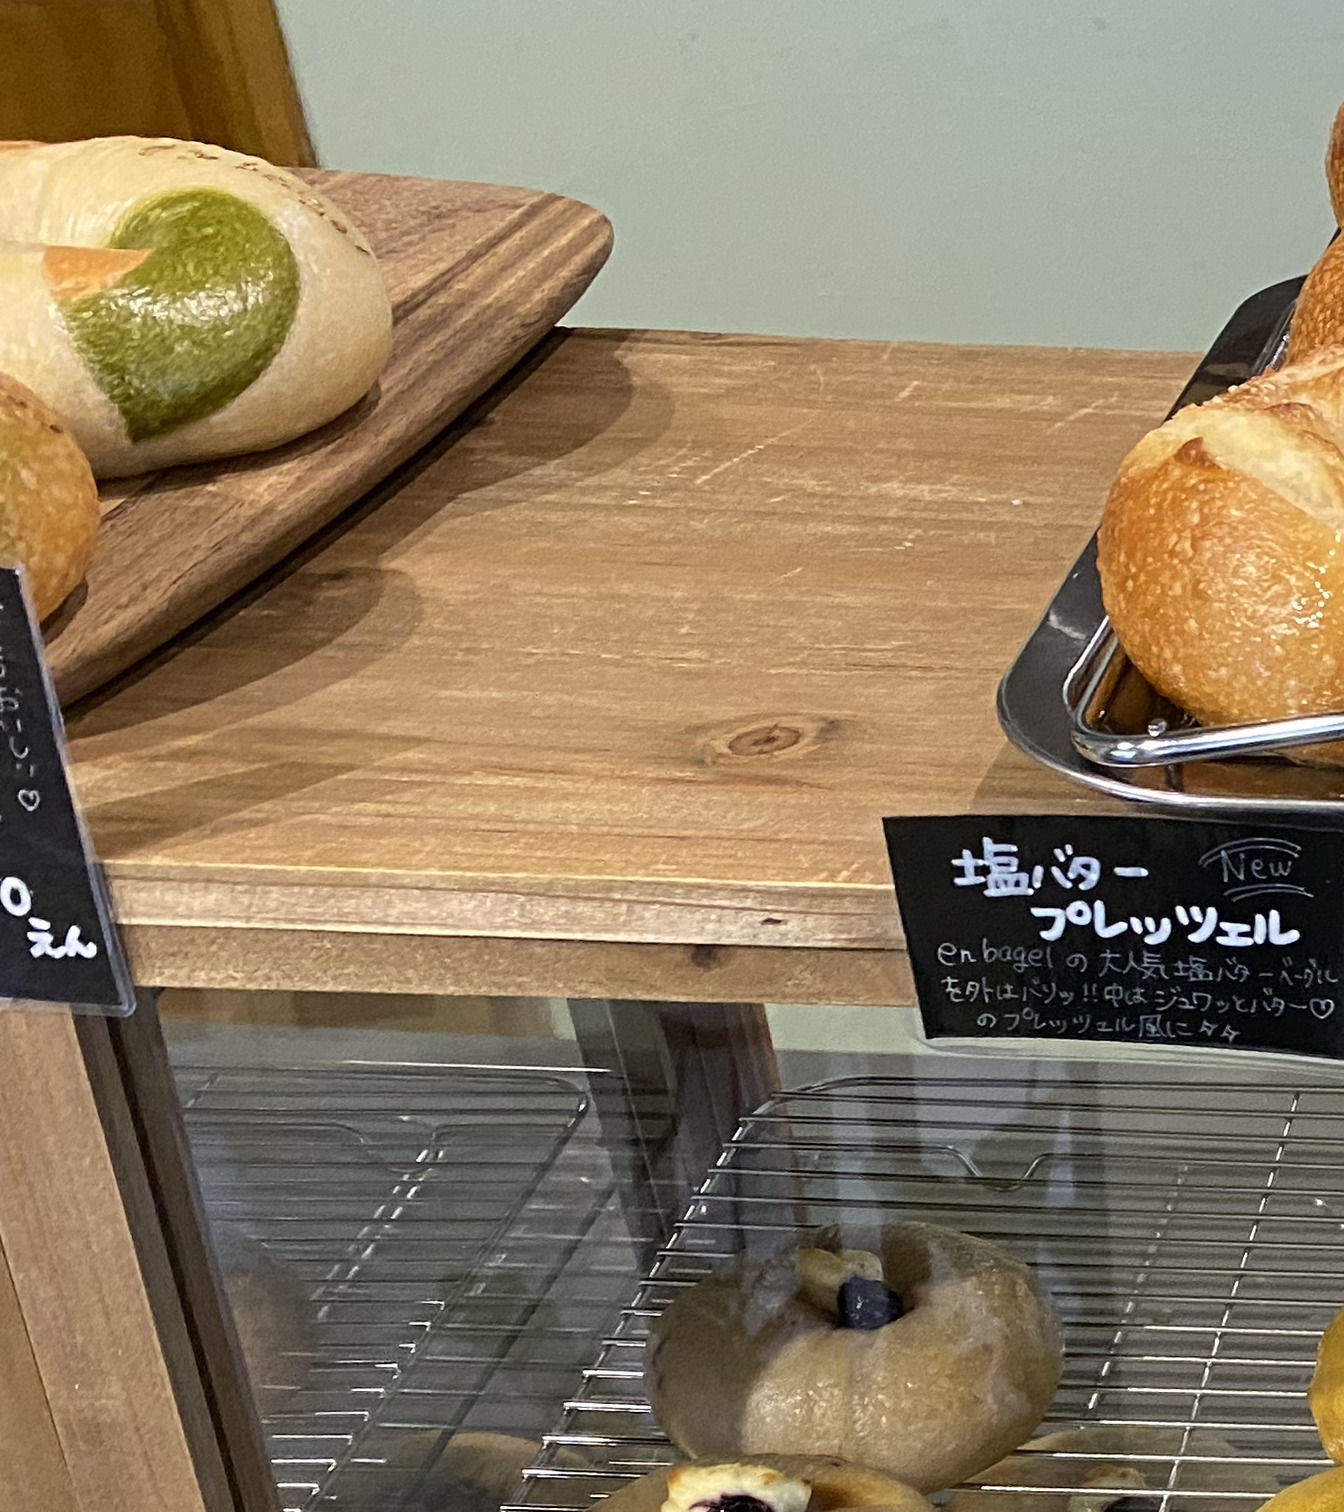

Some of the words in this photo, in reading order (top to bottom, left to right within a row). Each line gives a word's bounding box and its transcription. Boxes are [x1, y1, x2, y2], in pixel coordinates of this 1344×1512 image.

[951, 836, 1150, 898] 塩バター
[1219, 848, 1293, 884] New
[1030, 899, 1301, 947] プレッツェル
[936, 942, 977, 967] en
[981, 937, 1054, 973] bagel
